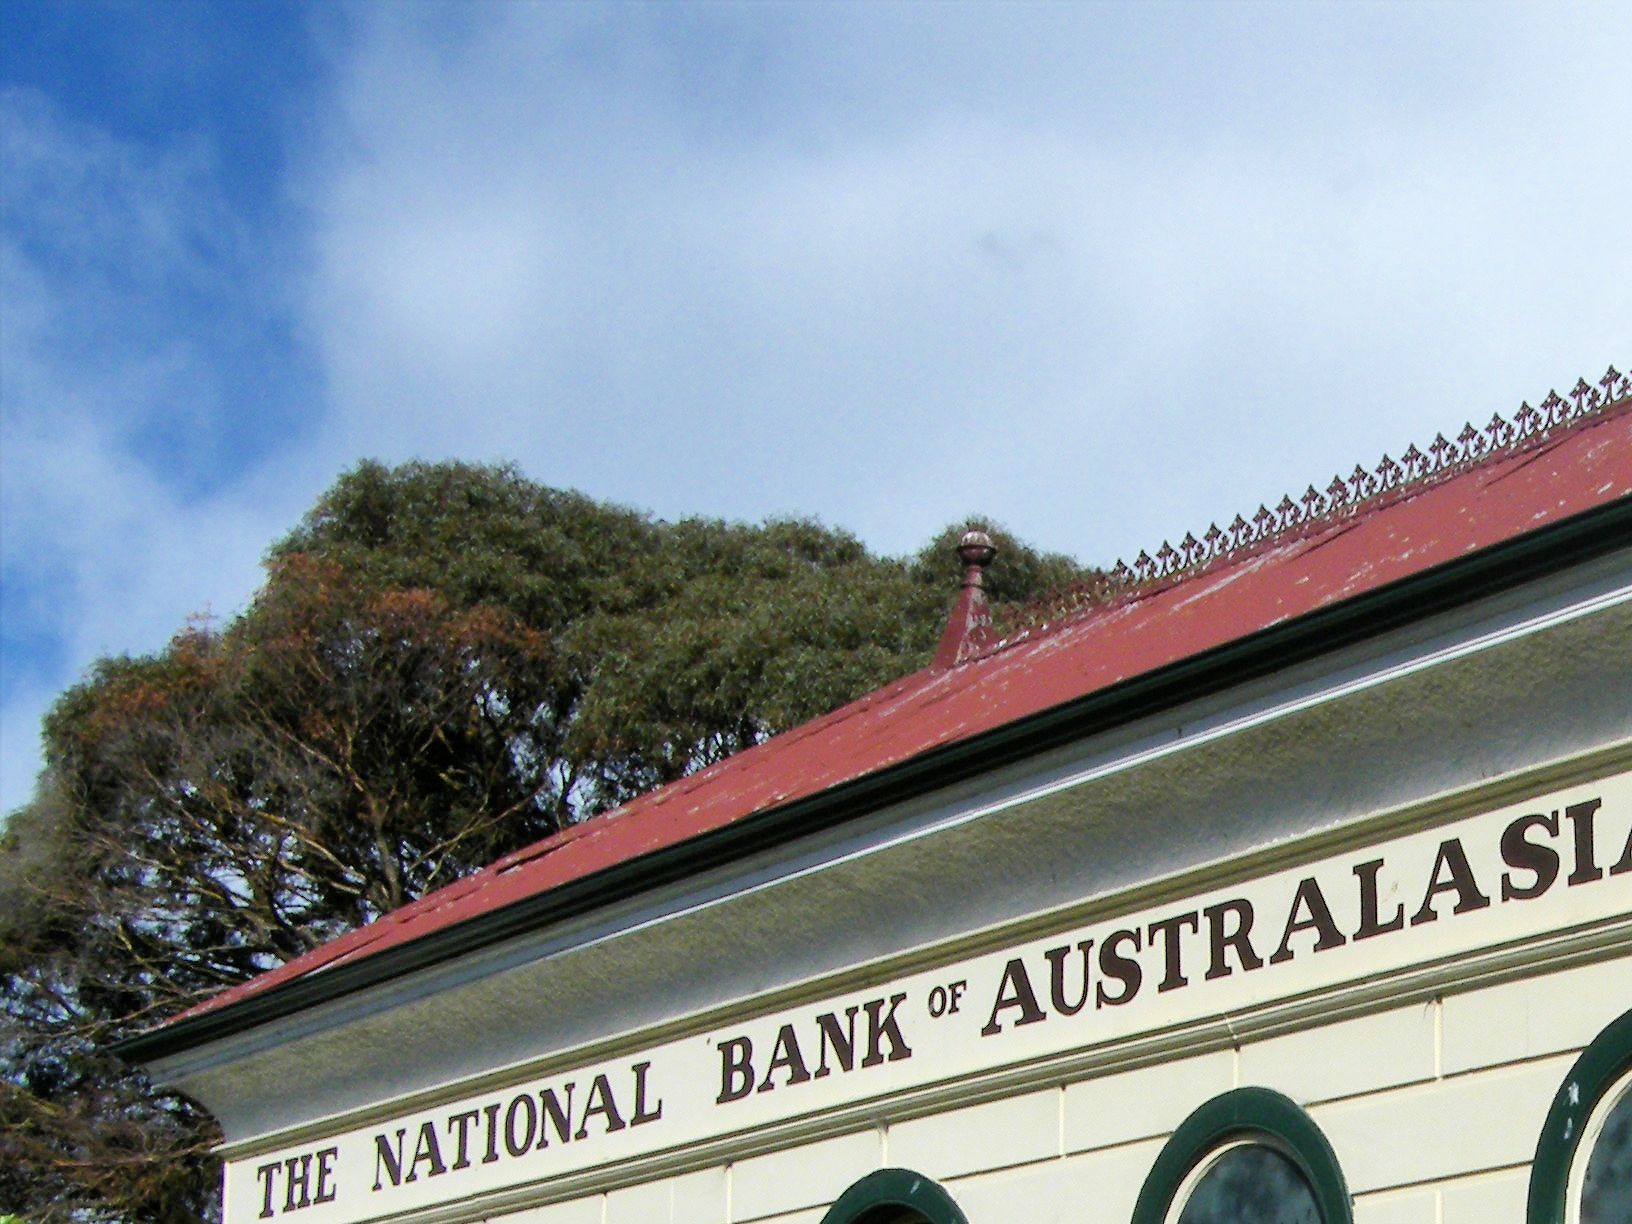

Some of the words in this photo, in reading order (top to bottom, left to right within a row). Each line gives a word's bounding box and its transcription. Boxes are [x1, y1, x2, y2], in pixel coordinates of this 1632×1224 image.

[257, 1147, 338, 1219] THE
[372, 1061, 663, 1191] NATIONAL
[716, 992, 912, 1104] BANK
[929, 980, 967, 1018] OF
